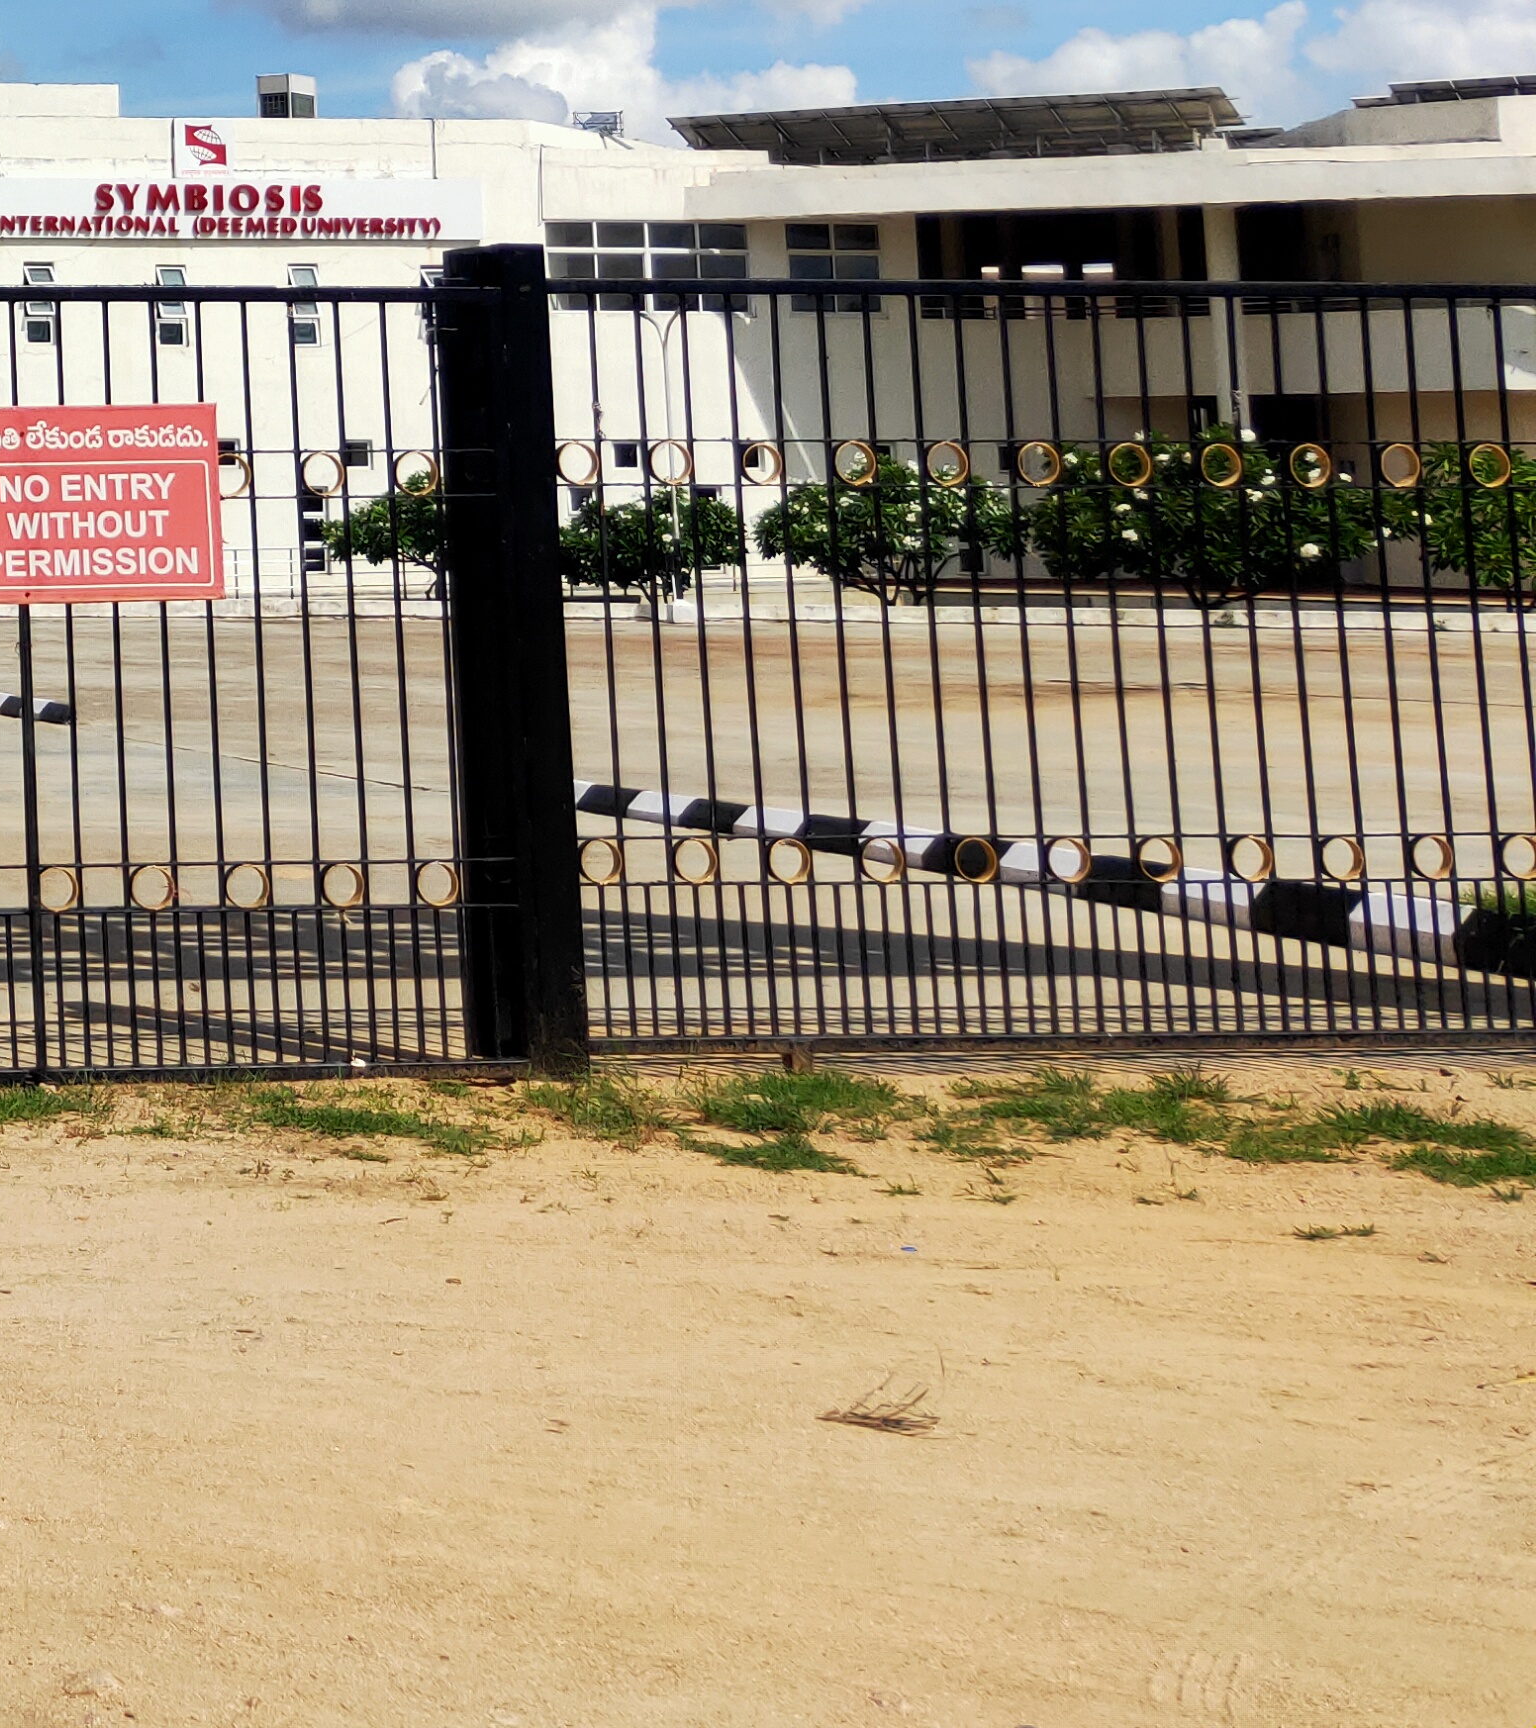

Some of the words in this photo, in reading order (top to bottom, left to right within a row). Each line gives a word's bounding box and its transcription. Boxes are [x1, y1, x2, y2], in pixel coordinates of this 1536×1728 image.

[94, 183, 324, 215] SYMBIOSIS
[192, 216, 298, 238] (DEEMED
[300, 217, 441, 238] UNIVERSITY)
[26, 420, 103, 450] లేకుండ
[0, 474, 50, 503] NO
[60, 472, 176, 502] ENTRY
[6, 509, 169, 540] WITHOUT
